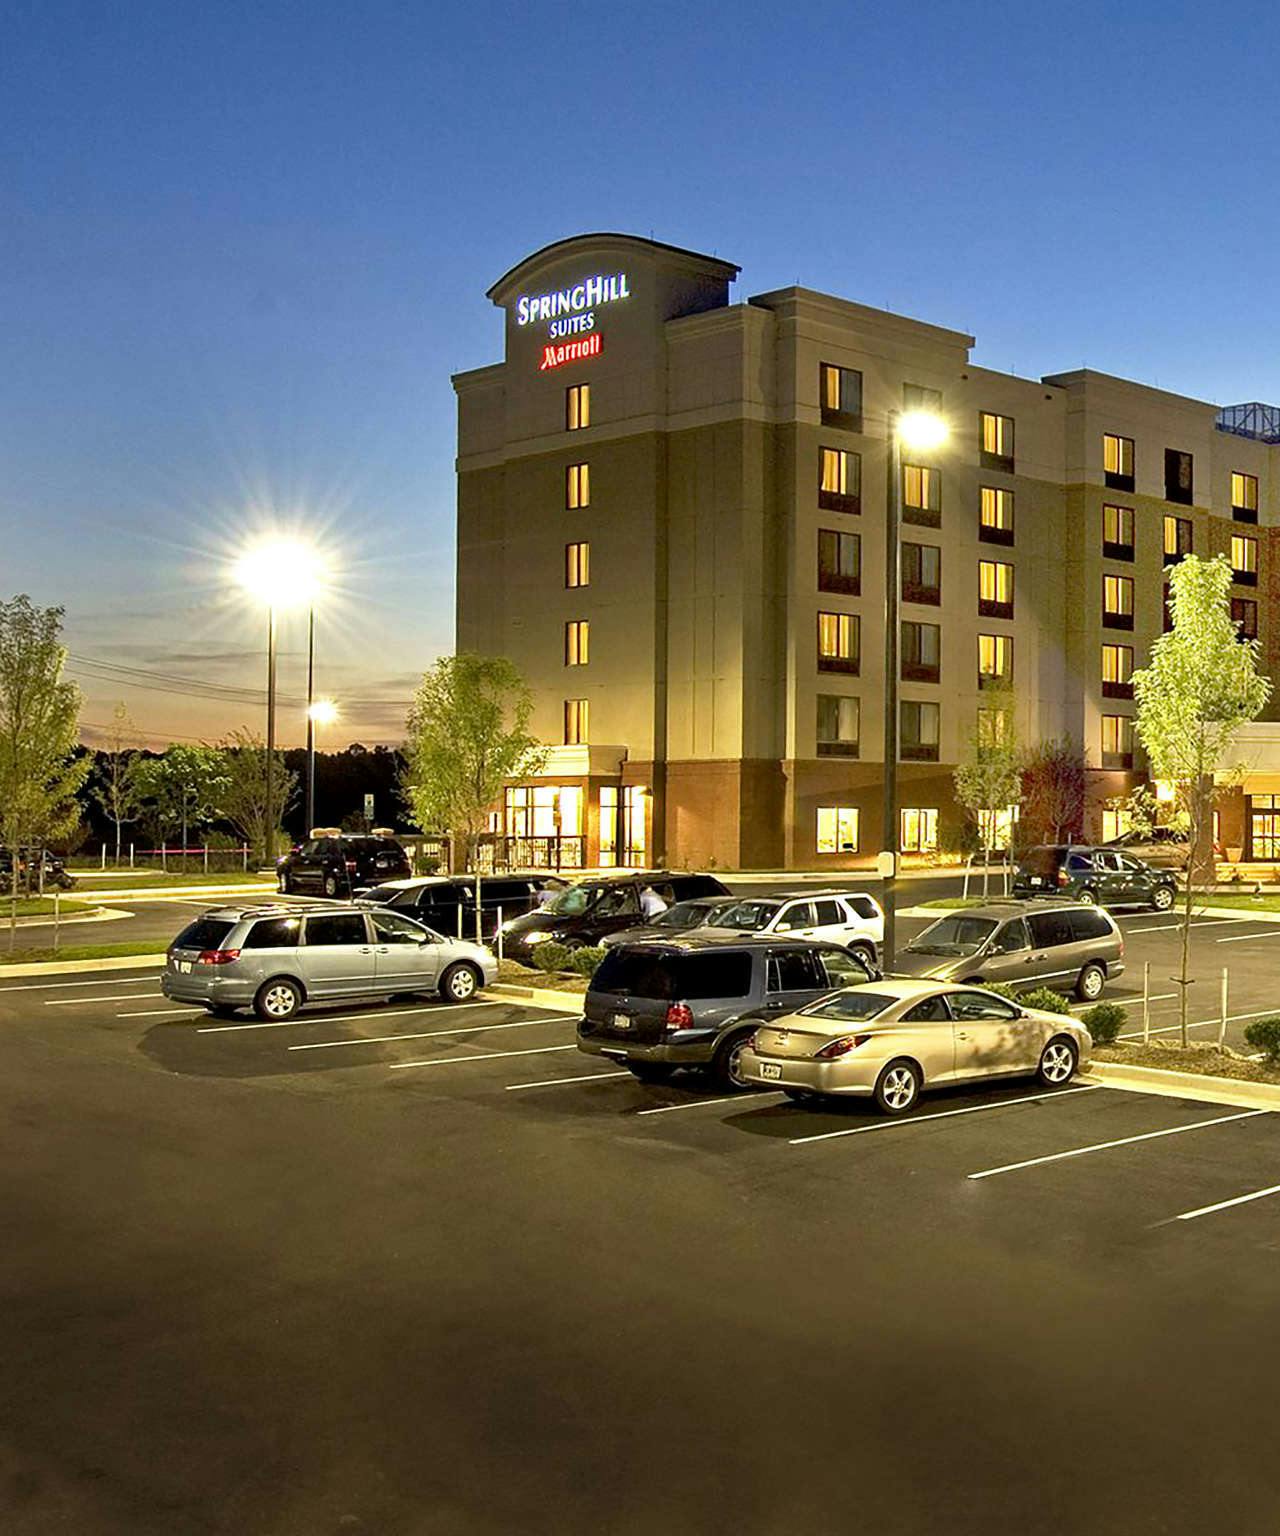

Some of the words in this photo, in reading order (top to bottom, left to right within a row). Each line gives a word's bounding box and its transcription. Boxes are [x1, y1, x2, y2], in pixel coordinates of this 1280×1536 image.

[517, 274, 630, 326] SPRINGHILL
[550, 312, 595, 339] SUITES
[540, 333, 601, 370] Marriott
